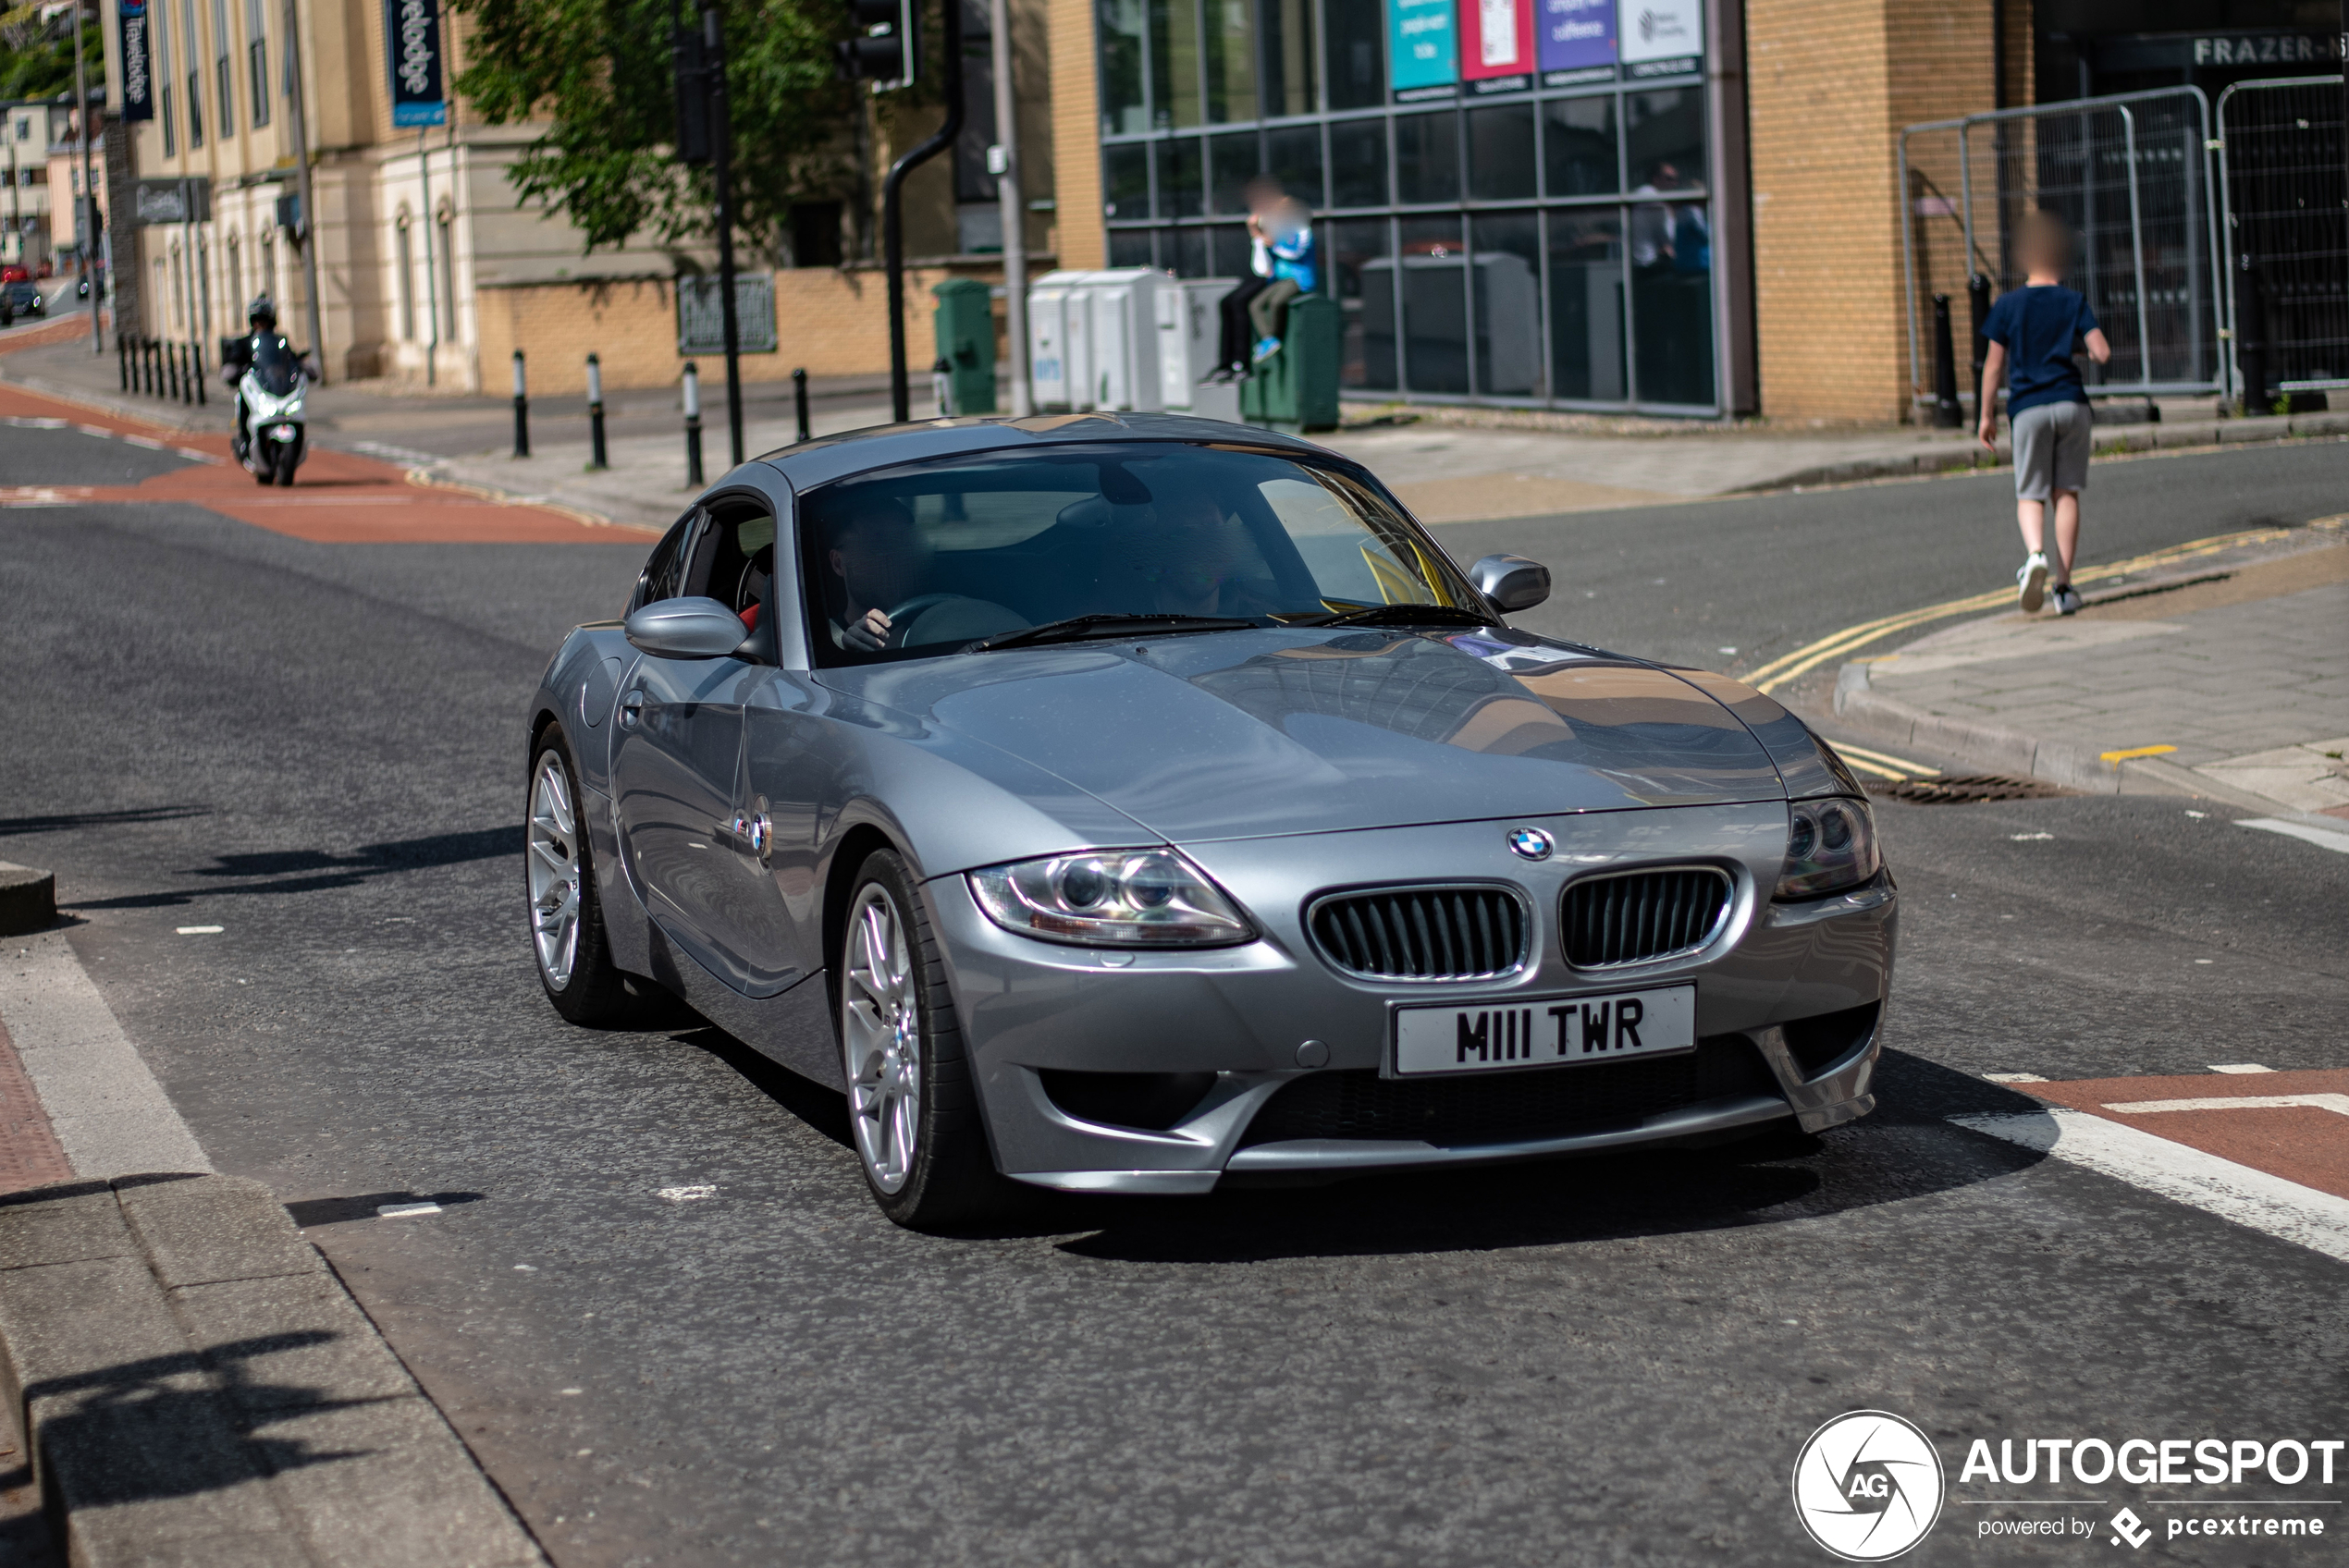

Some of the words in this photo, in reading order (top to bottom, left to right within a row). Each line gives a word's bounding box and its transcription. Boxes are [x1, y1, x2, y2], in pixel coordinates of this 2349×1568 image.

[126, 14, 147, 104] Travelodge
[399, 0, 433, 94] elodge
[1547, 998, 1643, 1056] TWR
